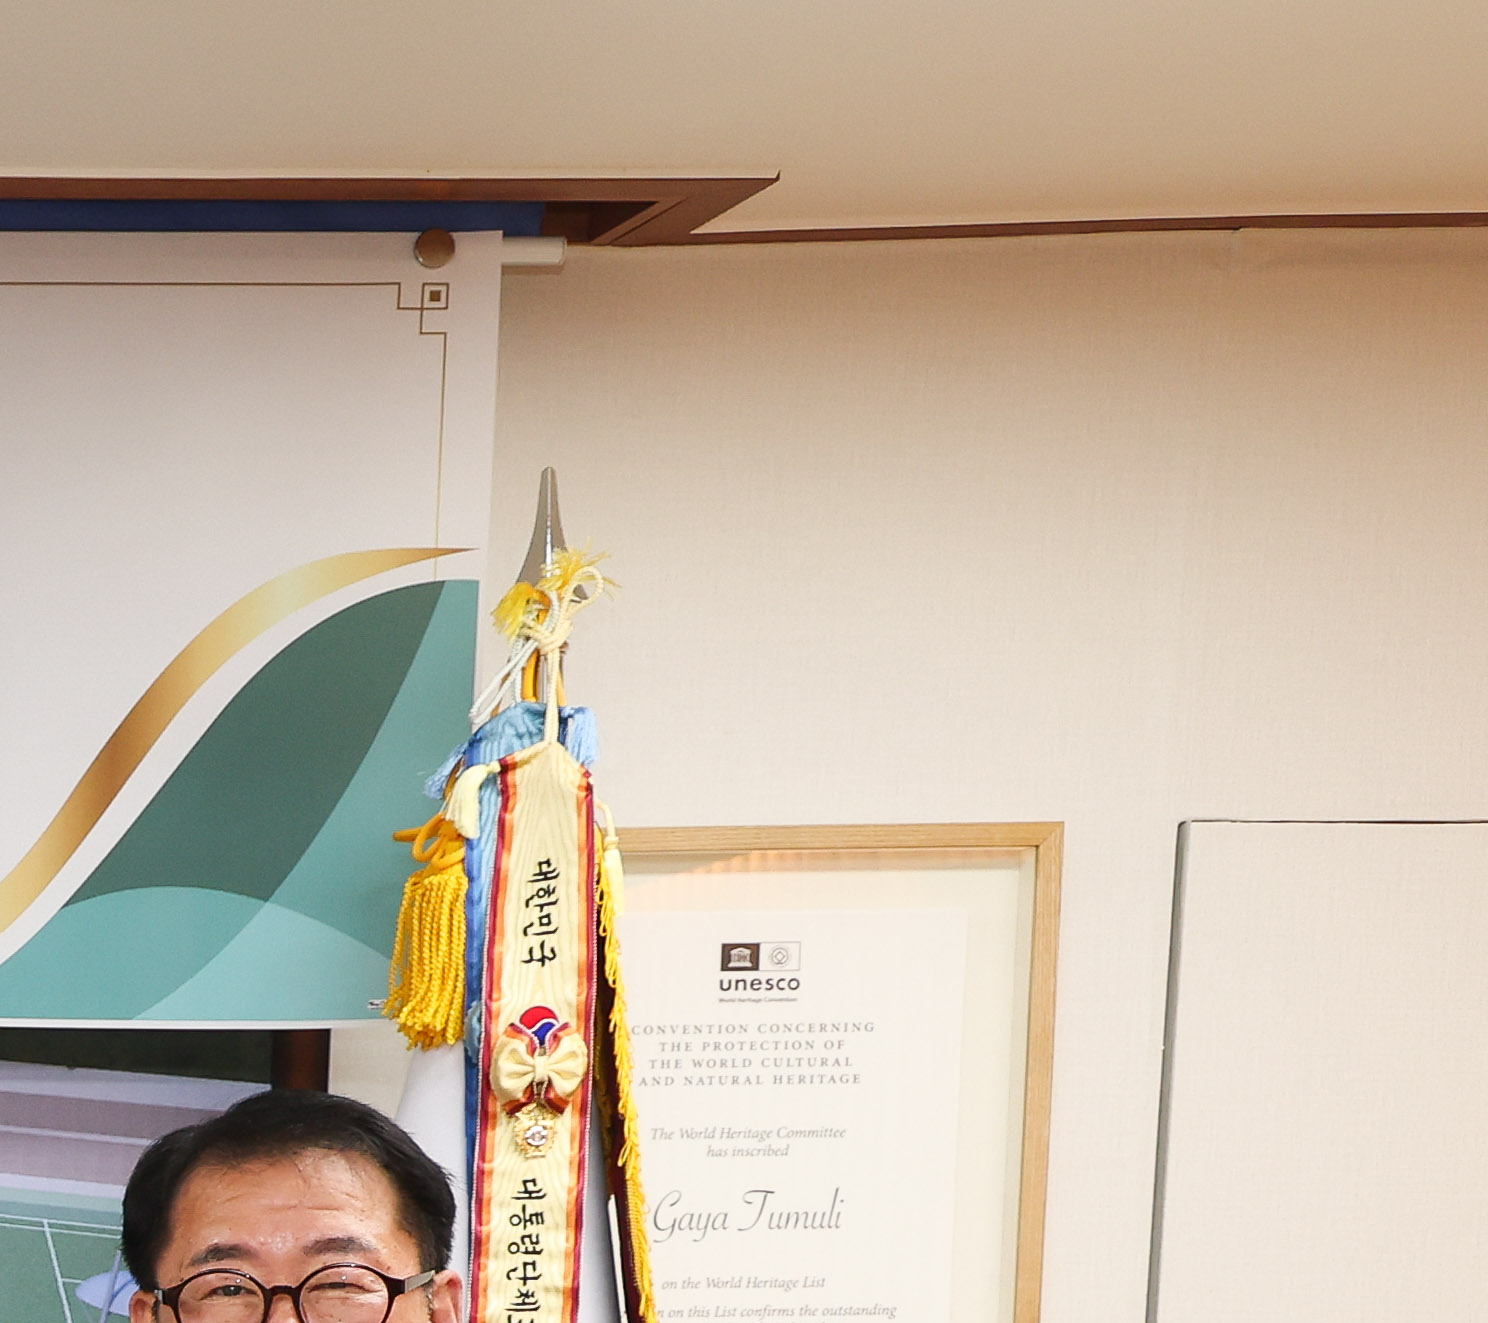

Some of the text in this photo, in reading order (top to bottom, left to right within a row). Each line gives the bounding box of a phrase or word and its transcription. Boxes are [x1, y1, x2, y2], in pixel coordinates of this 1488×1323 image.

[520, 858, 560, 967] 대한민국
[719, 977, 800, 992] unesco
[631, 1022, 876, 1036] CONVENTION CONCERNING
[659, 1039, 846, 1052] THE PROTECTION OF
[649, 1056, 854, 1069] THE WORLD CULTURAL
[639, 1073, 861, 1087] AND NATURAL HERITAGE
[650, 1126, 846, 1142] The World Heritage Committee
[706, 1144, 790, 1158] has inscribed
[653, 1187, 846, 1243] Gaya Tumuli
[661, 1277, 826, 1292] on the World Heritage List
[668, 1307, 684, 1318] on
[688, 1305, 710, 1318] this
[714, 1305, 737, 1318] List
[740, 1304, 795, 1322] confirms
[799, 1304, 818, 1317] the
[822, 1304, 897, 1319] outstanding
